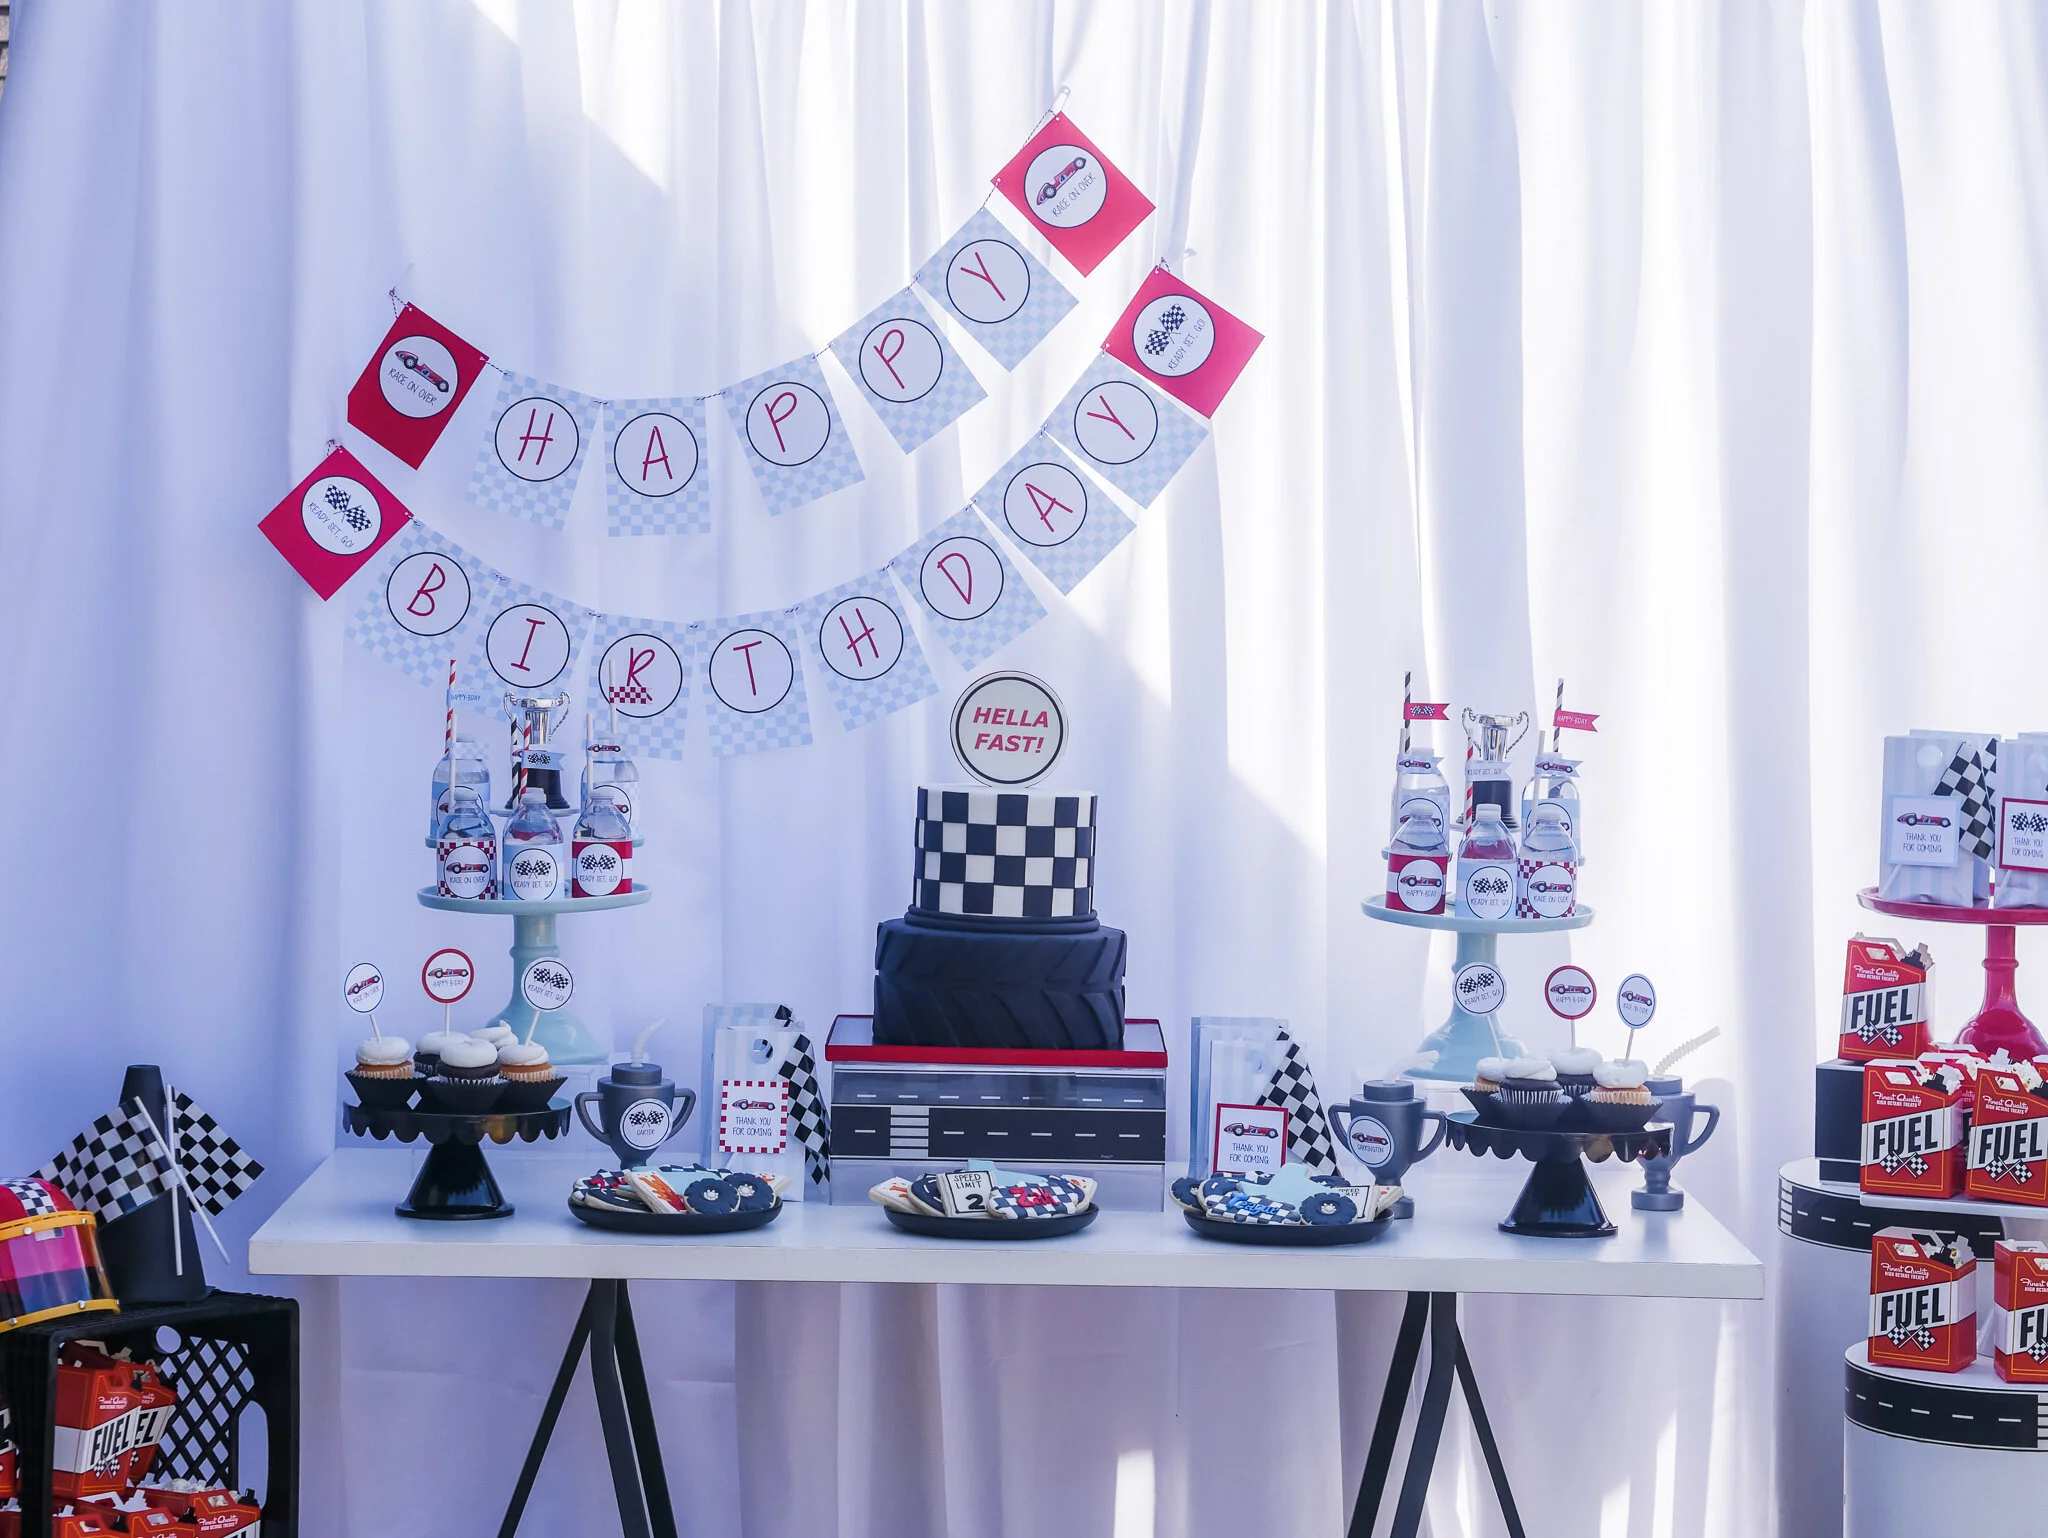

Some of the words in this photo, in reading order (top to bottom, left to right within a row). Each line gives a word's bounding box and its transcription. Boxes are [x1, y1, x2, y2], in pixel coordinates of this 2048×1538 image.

[1052, 198, 1070, 217] RACE
[1069, 188, 1080, 201] ON
[1078, 172, 1096, 191] OVER
[1168, 346, 1187, 371] READY
[388, 368, 408, 386] RACE
[407, 381, 420, 393] ON
[418, 389, 437, 406] OVER
[308, 502, 330, 524] READY
[973, 706, 1049, 728] HELLA
[974, 733, 1045, 754] FAST!
[1905, 832, 1927, 841] THANK
[1929, 834, 1942, 843] YOU
[2014, 836, 2031, 846] THANK
[2033, 838, 2044, 848] YOU
[1902, 843, 1914, 851] FOR
[1916, 843, 1942, 853] COMING
[2011, 847, 2021, 856] FOR
[1853, 964, 1876, 975] Finest
[1875, 967, 1900, 981] Quality
[1850, 988, 1913, 1030] FUEL
[1872, 1090, 1897, 1101] Finest
[1896, 1093, 1922, 1107] Quality
[1982, 1095, 2005, 1105] Finest
[2004, 1098, 2029, 1114] Quality
[735, 1116, 757, 1126] THANK
[759, 1117, 772, 1126] YOU
[732, 1126, 745, 1136] FOR
[746, 1127, 773, 1137] COMING
[1872, 1113, 1938, 1161] FUEL
[1232, 1142, 1254, 1152] THANK
[1256, 1144, 1269, 1154] YOU
[1978, 1121, 2043, 1165] FUEL
[1229, 1153, 1242, 1163] FOR
[1243, 1154, 1270, 1165] COMING
[953, 1173, 982, 1183] SPEED
[955, 1181, 982, 1190] LIMIT
[965, 1193, 986, 1210] 2
[1880, 1262, 1905, 1273] Finest
[1904, 1265, 1930, 1280] Quality
[2020, 1277, 2046, 1287] Finest
[1880, 1287, 1945, 1332] FUEL
[2019, 1308, 2048, 1349] FU
[134, 1410, 159, 1446] EL
[90, 1414, 131, 1467] FUEL
